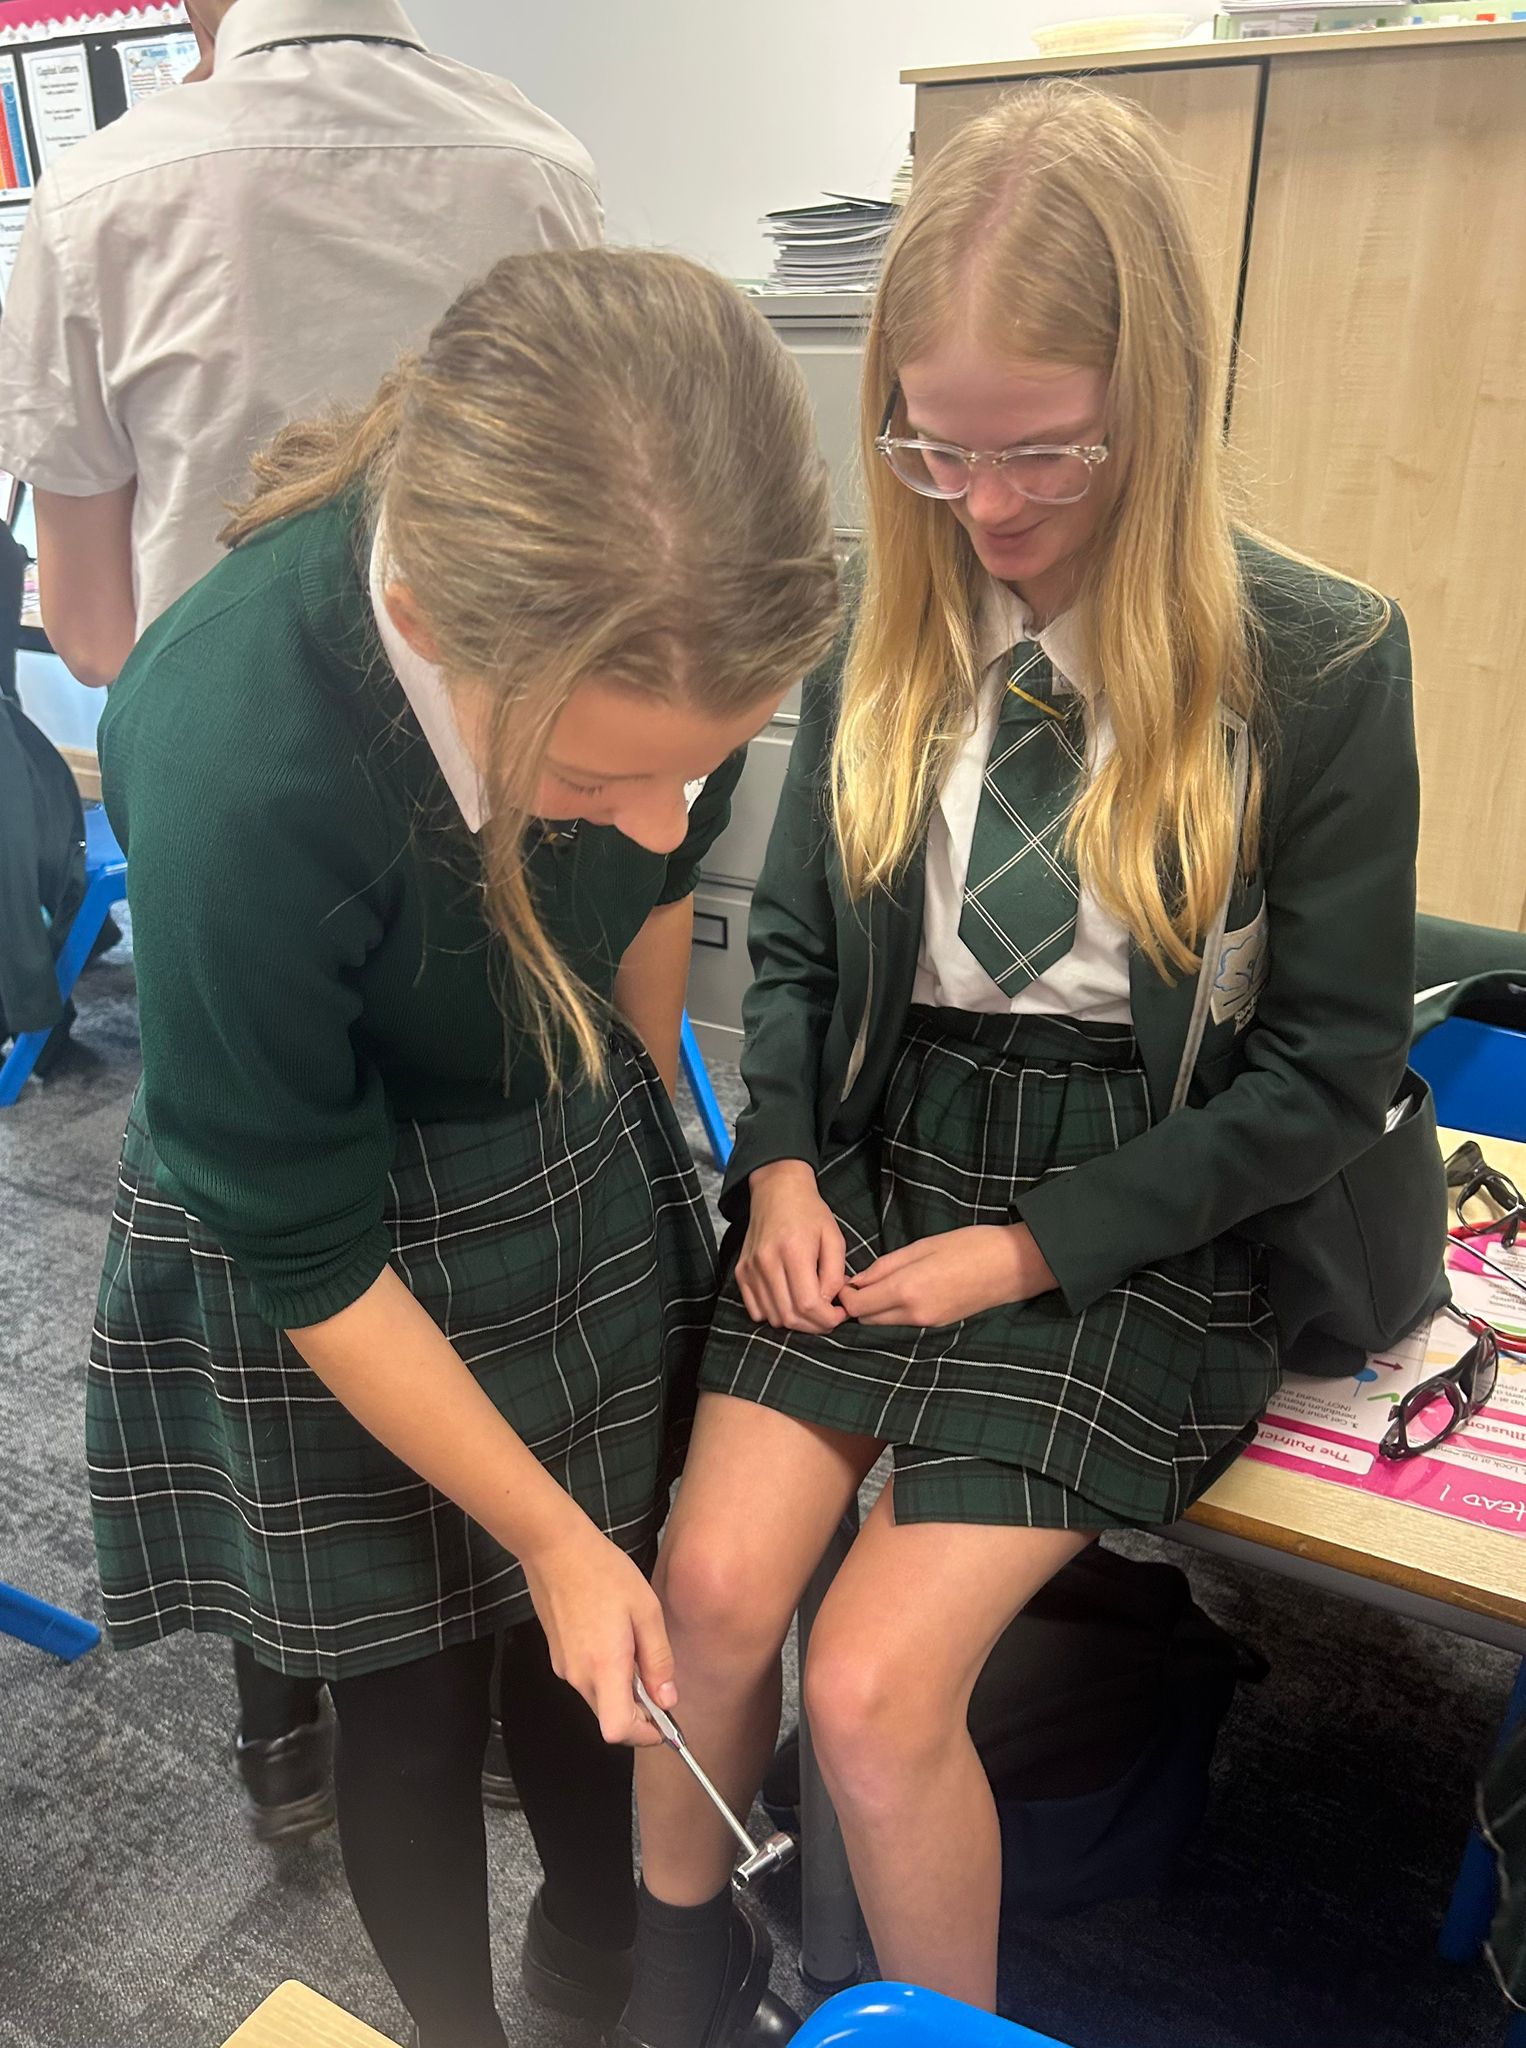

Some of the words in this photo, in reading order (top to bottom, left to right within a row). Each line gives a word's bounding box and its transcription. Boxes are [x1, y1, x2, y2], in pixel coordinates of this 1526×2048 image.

[1283, 1396, 1306, 1409] from
[1296, 1392, 1324, 1405] round
[1278, 1402, 1305, 1414] friend
[1308, 1403, 1357, 1420] pendulum
[1327, 1401, 1351, 1411] (NOT
[1307, 1410, 1329, 1419] your
[1331, 1417, 1348, 1426] Get
[1320, 1447, 1350, 1463] The
